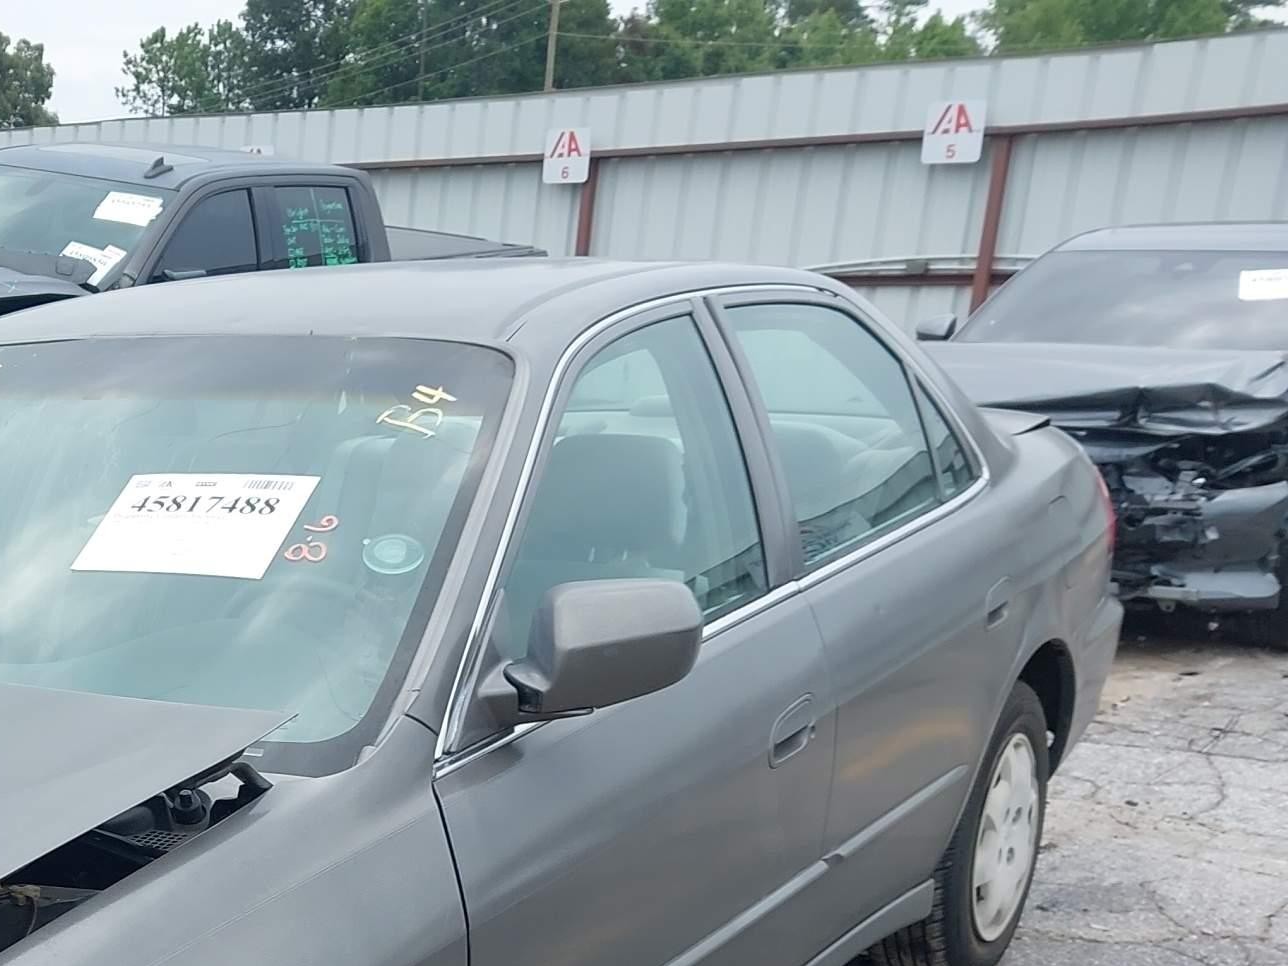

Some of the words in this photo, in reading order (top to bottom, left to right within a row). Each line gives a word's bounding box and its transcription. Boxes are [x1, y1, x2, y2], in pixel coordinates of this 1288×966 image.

[945, 143, 957, 159] 5
[560, 166, 569, 179] 6
[130, 495, 281, 515] 45817488
